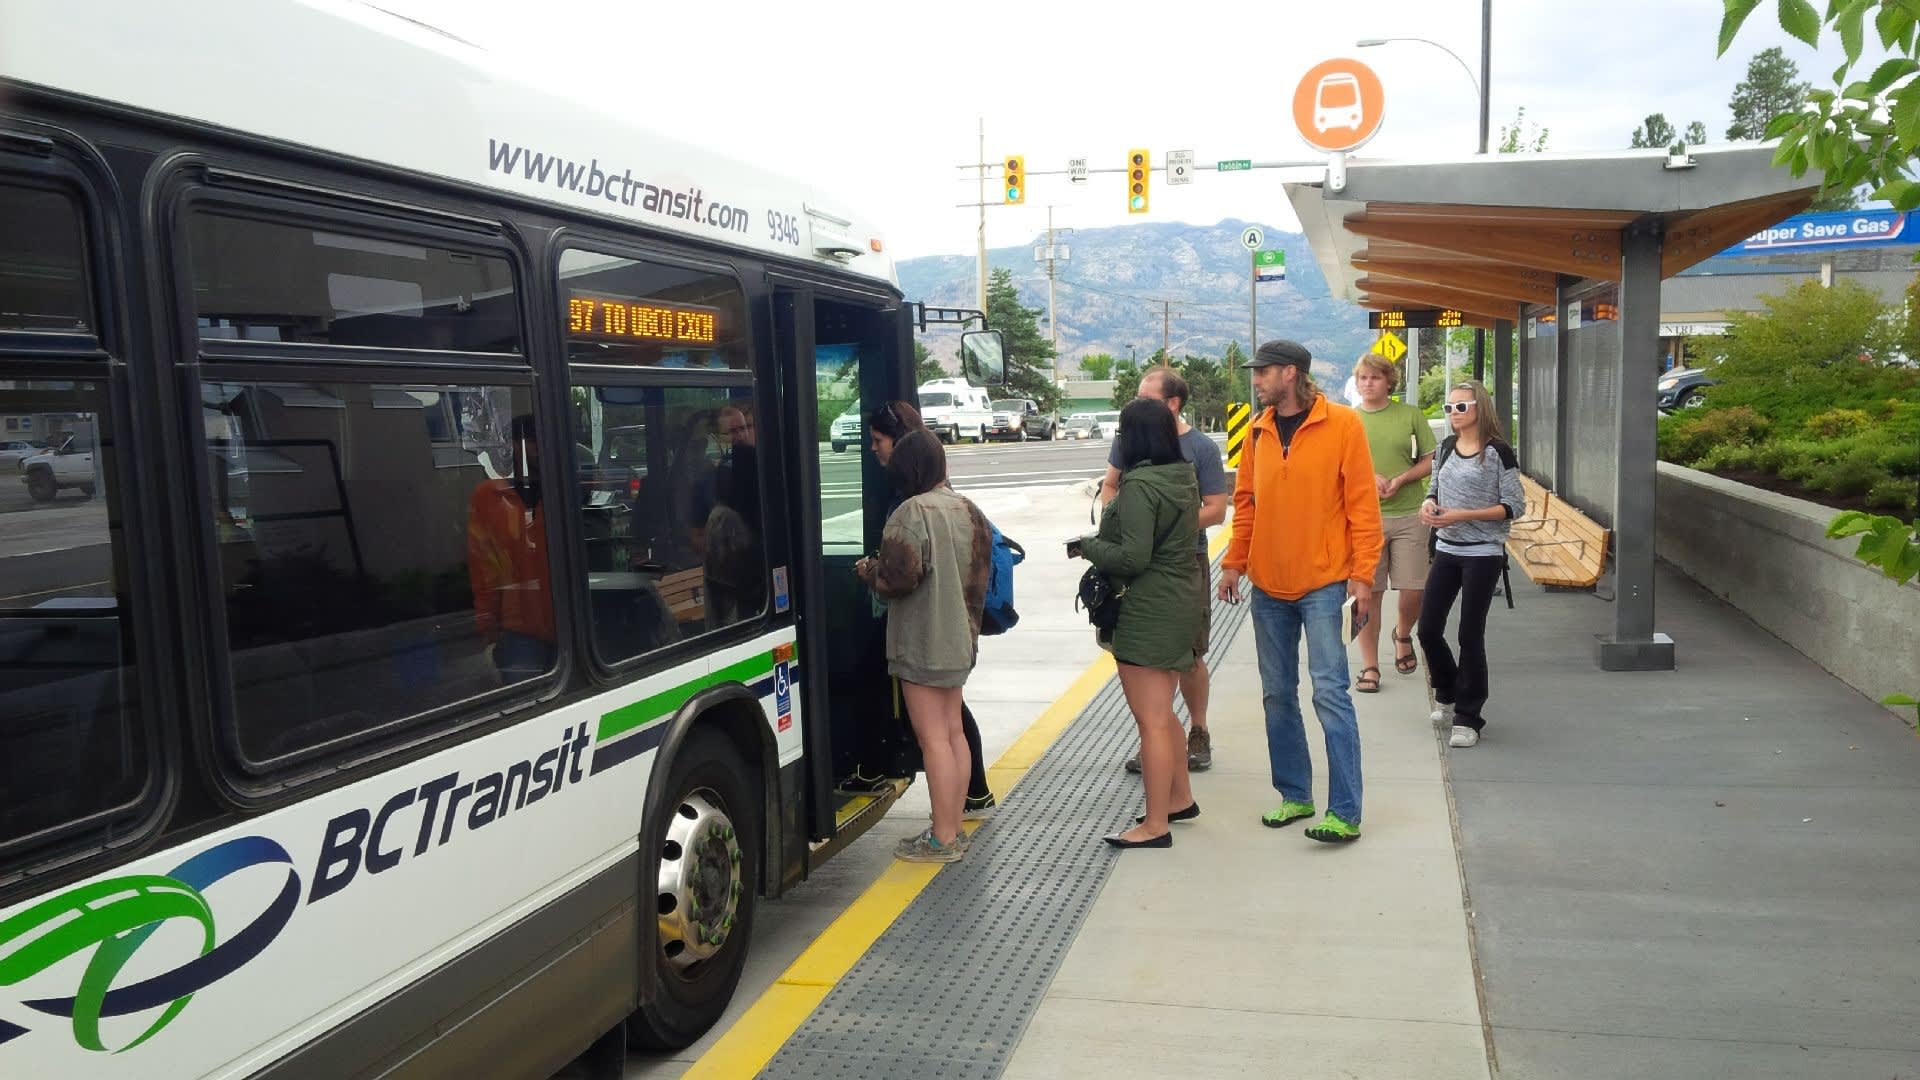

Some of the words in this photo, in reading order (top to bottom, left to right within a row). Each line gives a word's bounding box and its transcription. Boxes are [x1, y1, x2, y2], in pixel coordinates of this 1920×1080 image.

[1069, 159, 1087, 167] ONE
[1070, 167, 1087, 175] WAY
[489, 138, 749, 233] www.bctransit.com
[767, 209, 800, 246] 9346
[1247, 232, 1258, 244] A
[1802, 222, 1847, 238] Save
[1852, 217, 1890, 234] Gas
[570, 299, 594, 331] 97
[602, 302, 626, 334] TO
